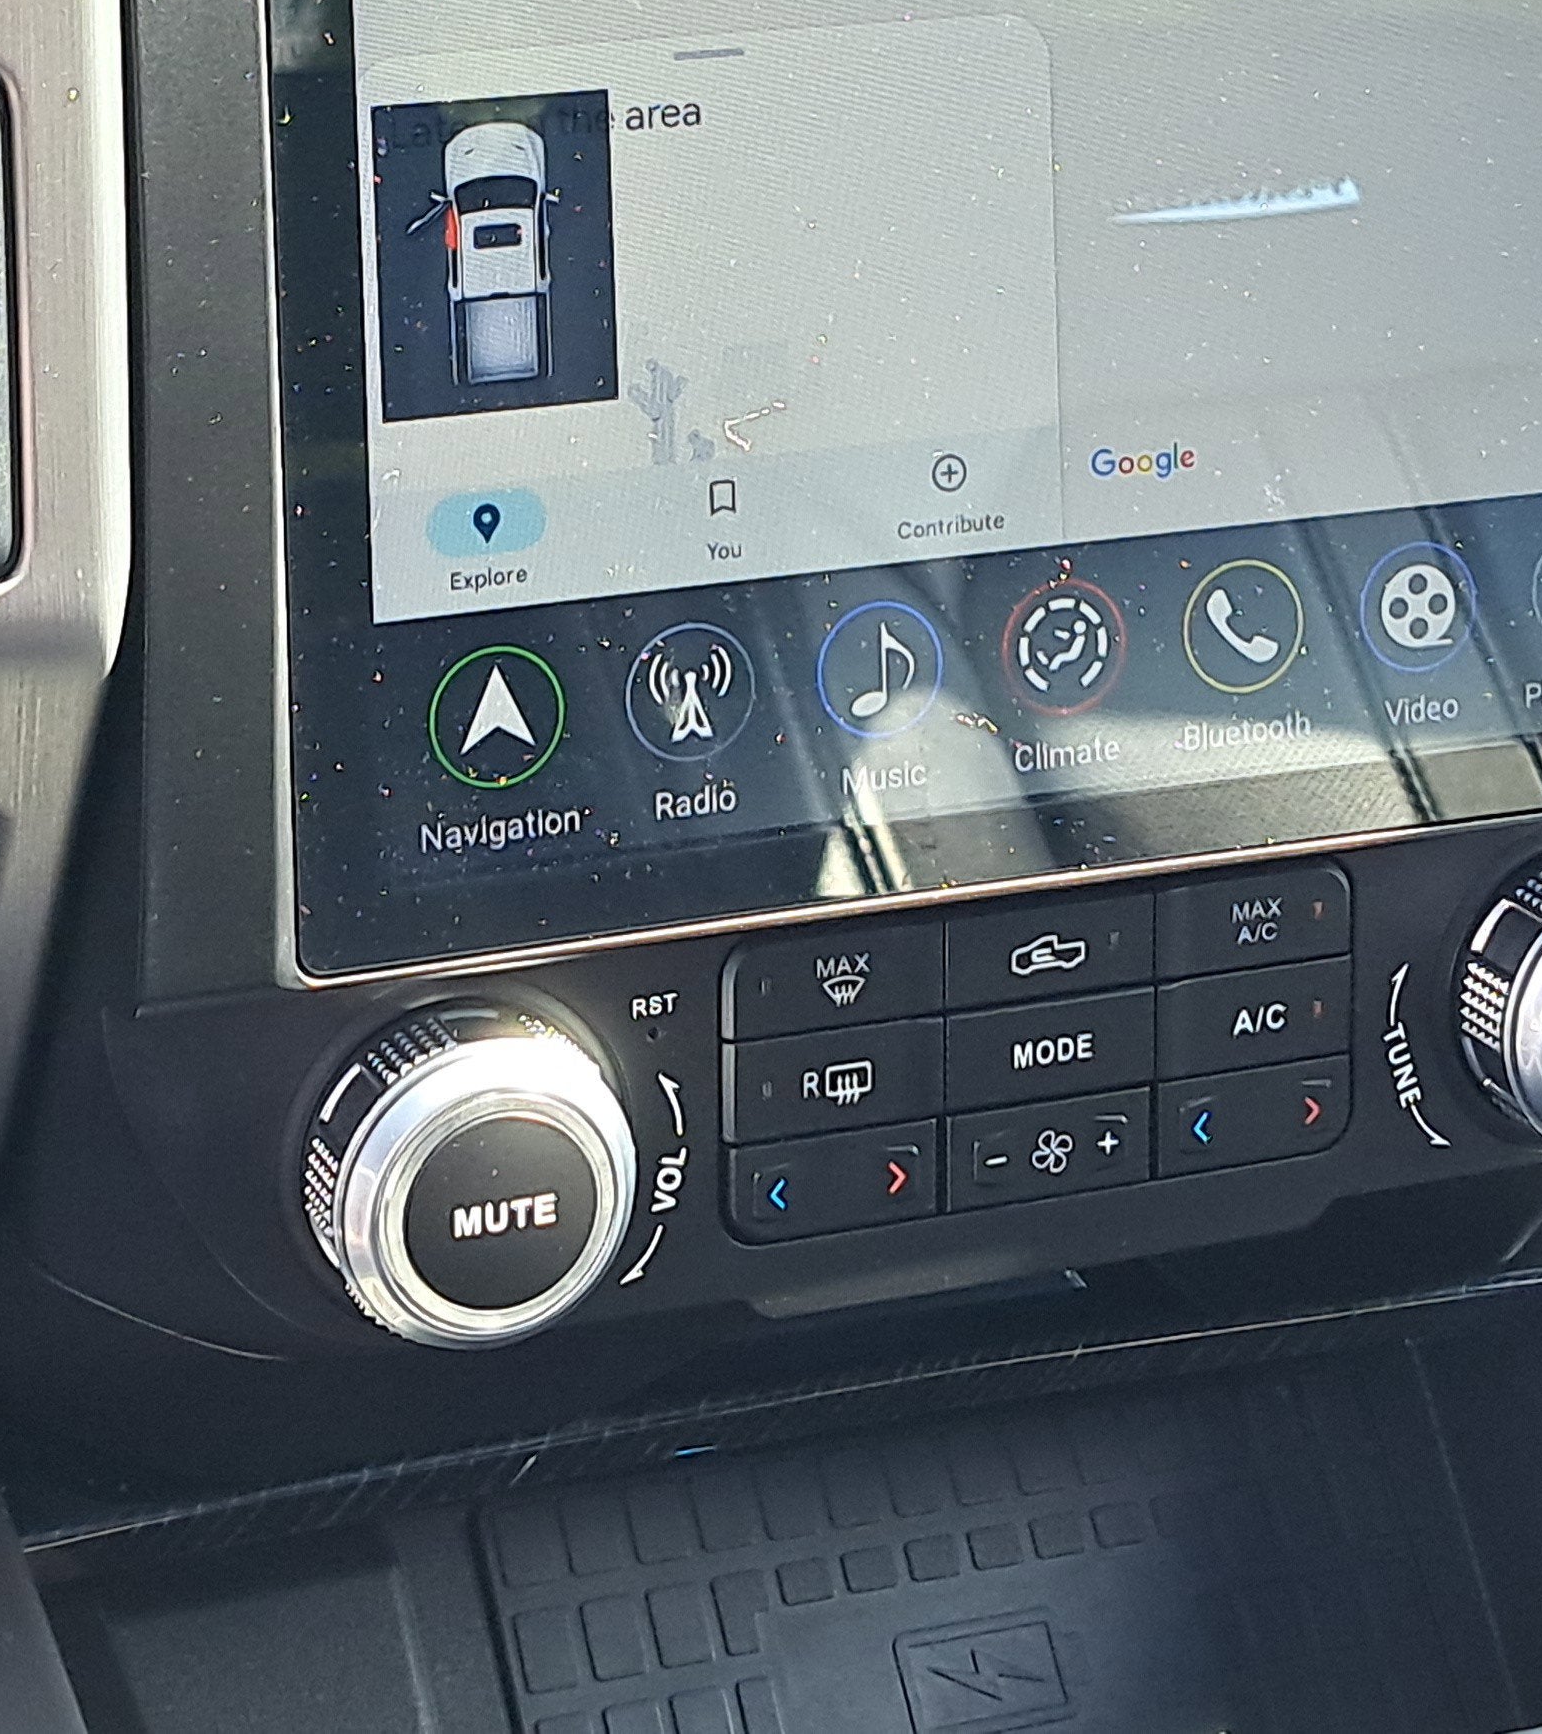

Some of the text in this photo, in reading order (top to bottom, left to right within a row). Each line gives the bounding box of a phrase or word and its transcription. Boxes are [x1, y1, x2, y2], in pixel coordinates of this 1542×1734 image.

[625, 99, 703, 132] area
[1091, 443, 1196, 479] Google
[898, 513, 1005, 540] Contribute
[707, 540, 742, 561] You
[450, 568, 528, 592] Explore
[1385, 695, 1460, 726] Video
[1181, 712, 1312, 752] Bluetooth
[1014, 736, 1120, 774] Climate
[842, 763, 926, 796] Music
[655, 785, 736, 820] Radio
[420, 808, 581, 854] Navigation
[1231, 896, 1283, 925] MAX
[1238, 920, 1279, 945] A/C
[816, 954, 870, 979] MAX
[631, 992, 679, 1021] RST
[1232, 1003, 1288, 1038] A/C
[1012, 1033, 1094, 1070] MODE
[1382, 1023, 1422, 1111] TUNE
[802, 1072, 820, 1100] R
[652, 1146, 688, 1214] VOL
[453, 1194, 558, 1239] MUTE
